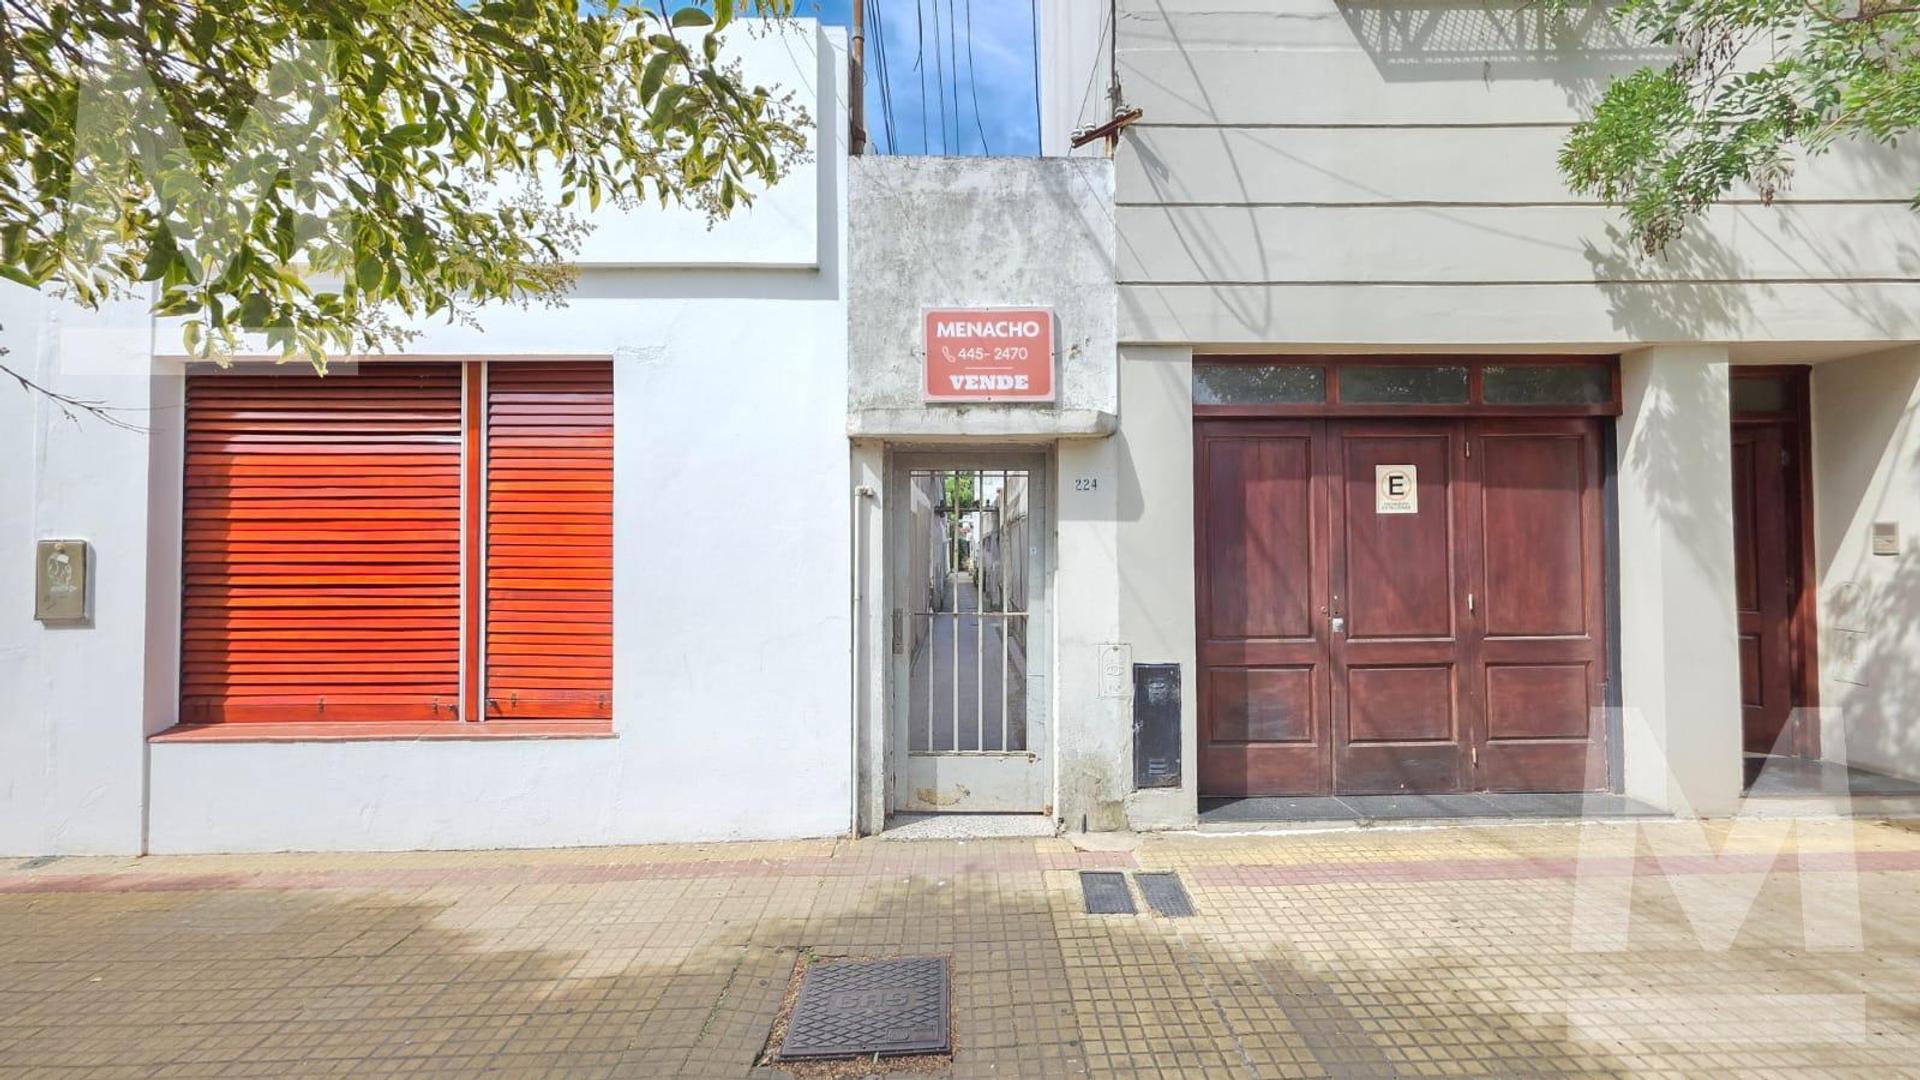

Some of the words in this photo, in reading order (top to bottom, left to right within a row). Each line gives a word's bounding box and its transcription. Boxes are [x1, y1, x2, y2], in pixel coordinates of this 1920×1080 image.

[936, 321, 1040, 338] MENACHO
[958, 347, 991, 360] 445-
[994, 347, 1028, 360] 2470
[949, 374, 1029, 391] VENDE
[1075, 479, 1097, 491] 224
[1389, 475, 1405, 496] E
